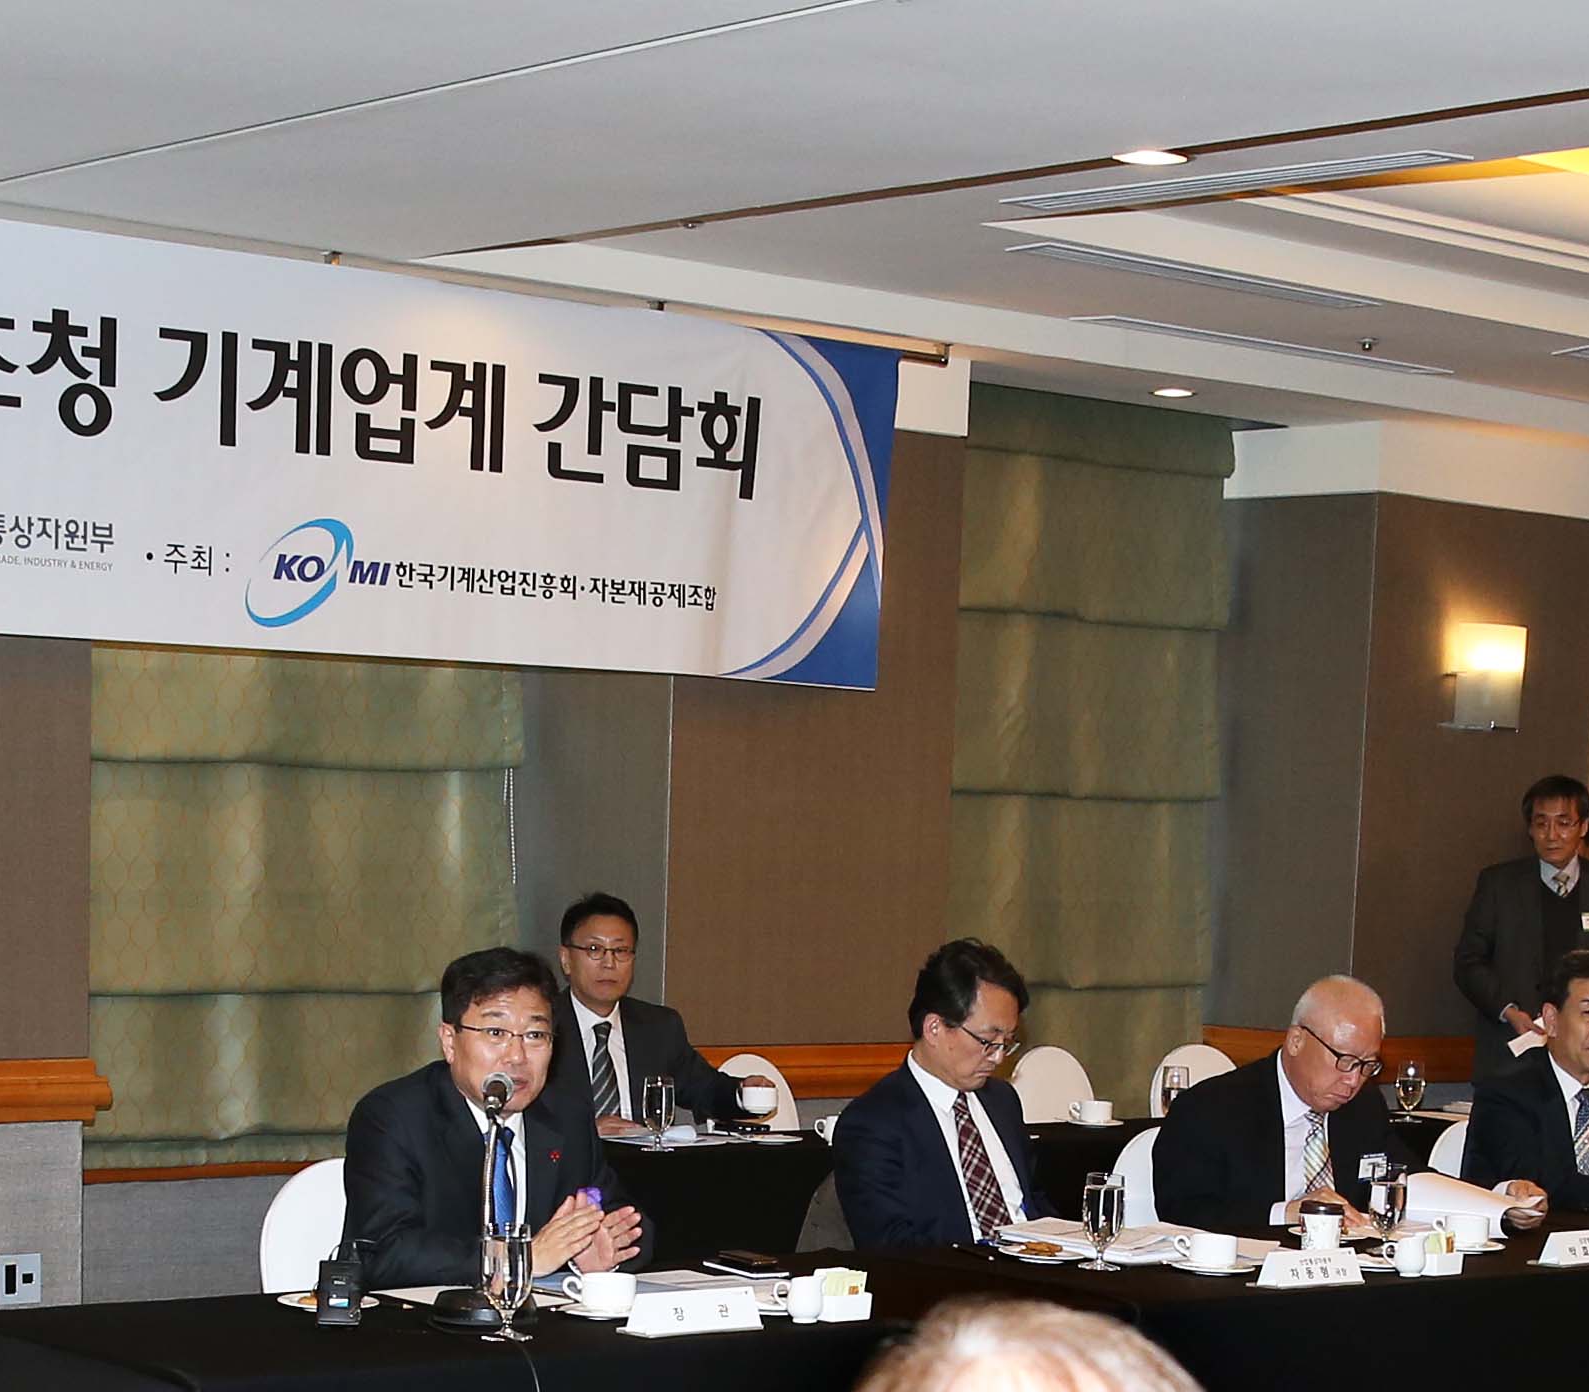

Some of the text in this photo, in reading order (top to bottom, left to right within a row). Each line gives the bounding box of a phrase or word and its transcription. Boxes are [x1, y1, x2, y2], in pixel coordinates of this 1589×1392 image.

[153, 326, 506, 474] 기계업계
[532, 372, 762, 501] 간담회
[23, 556, 68, 568] INDUSTRY
[70, 560, 76, 569] &
[78, 561, 113, 573] ENERGY
[163, 543, 213, 577] 주최
[394, 561, 717, 612] 한국기계산업진흥회·자본재공제조합
